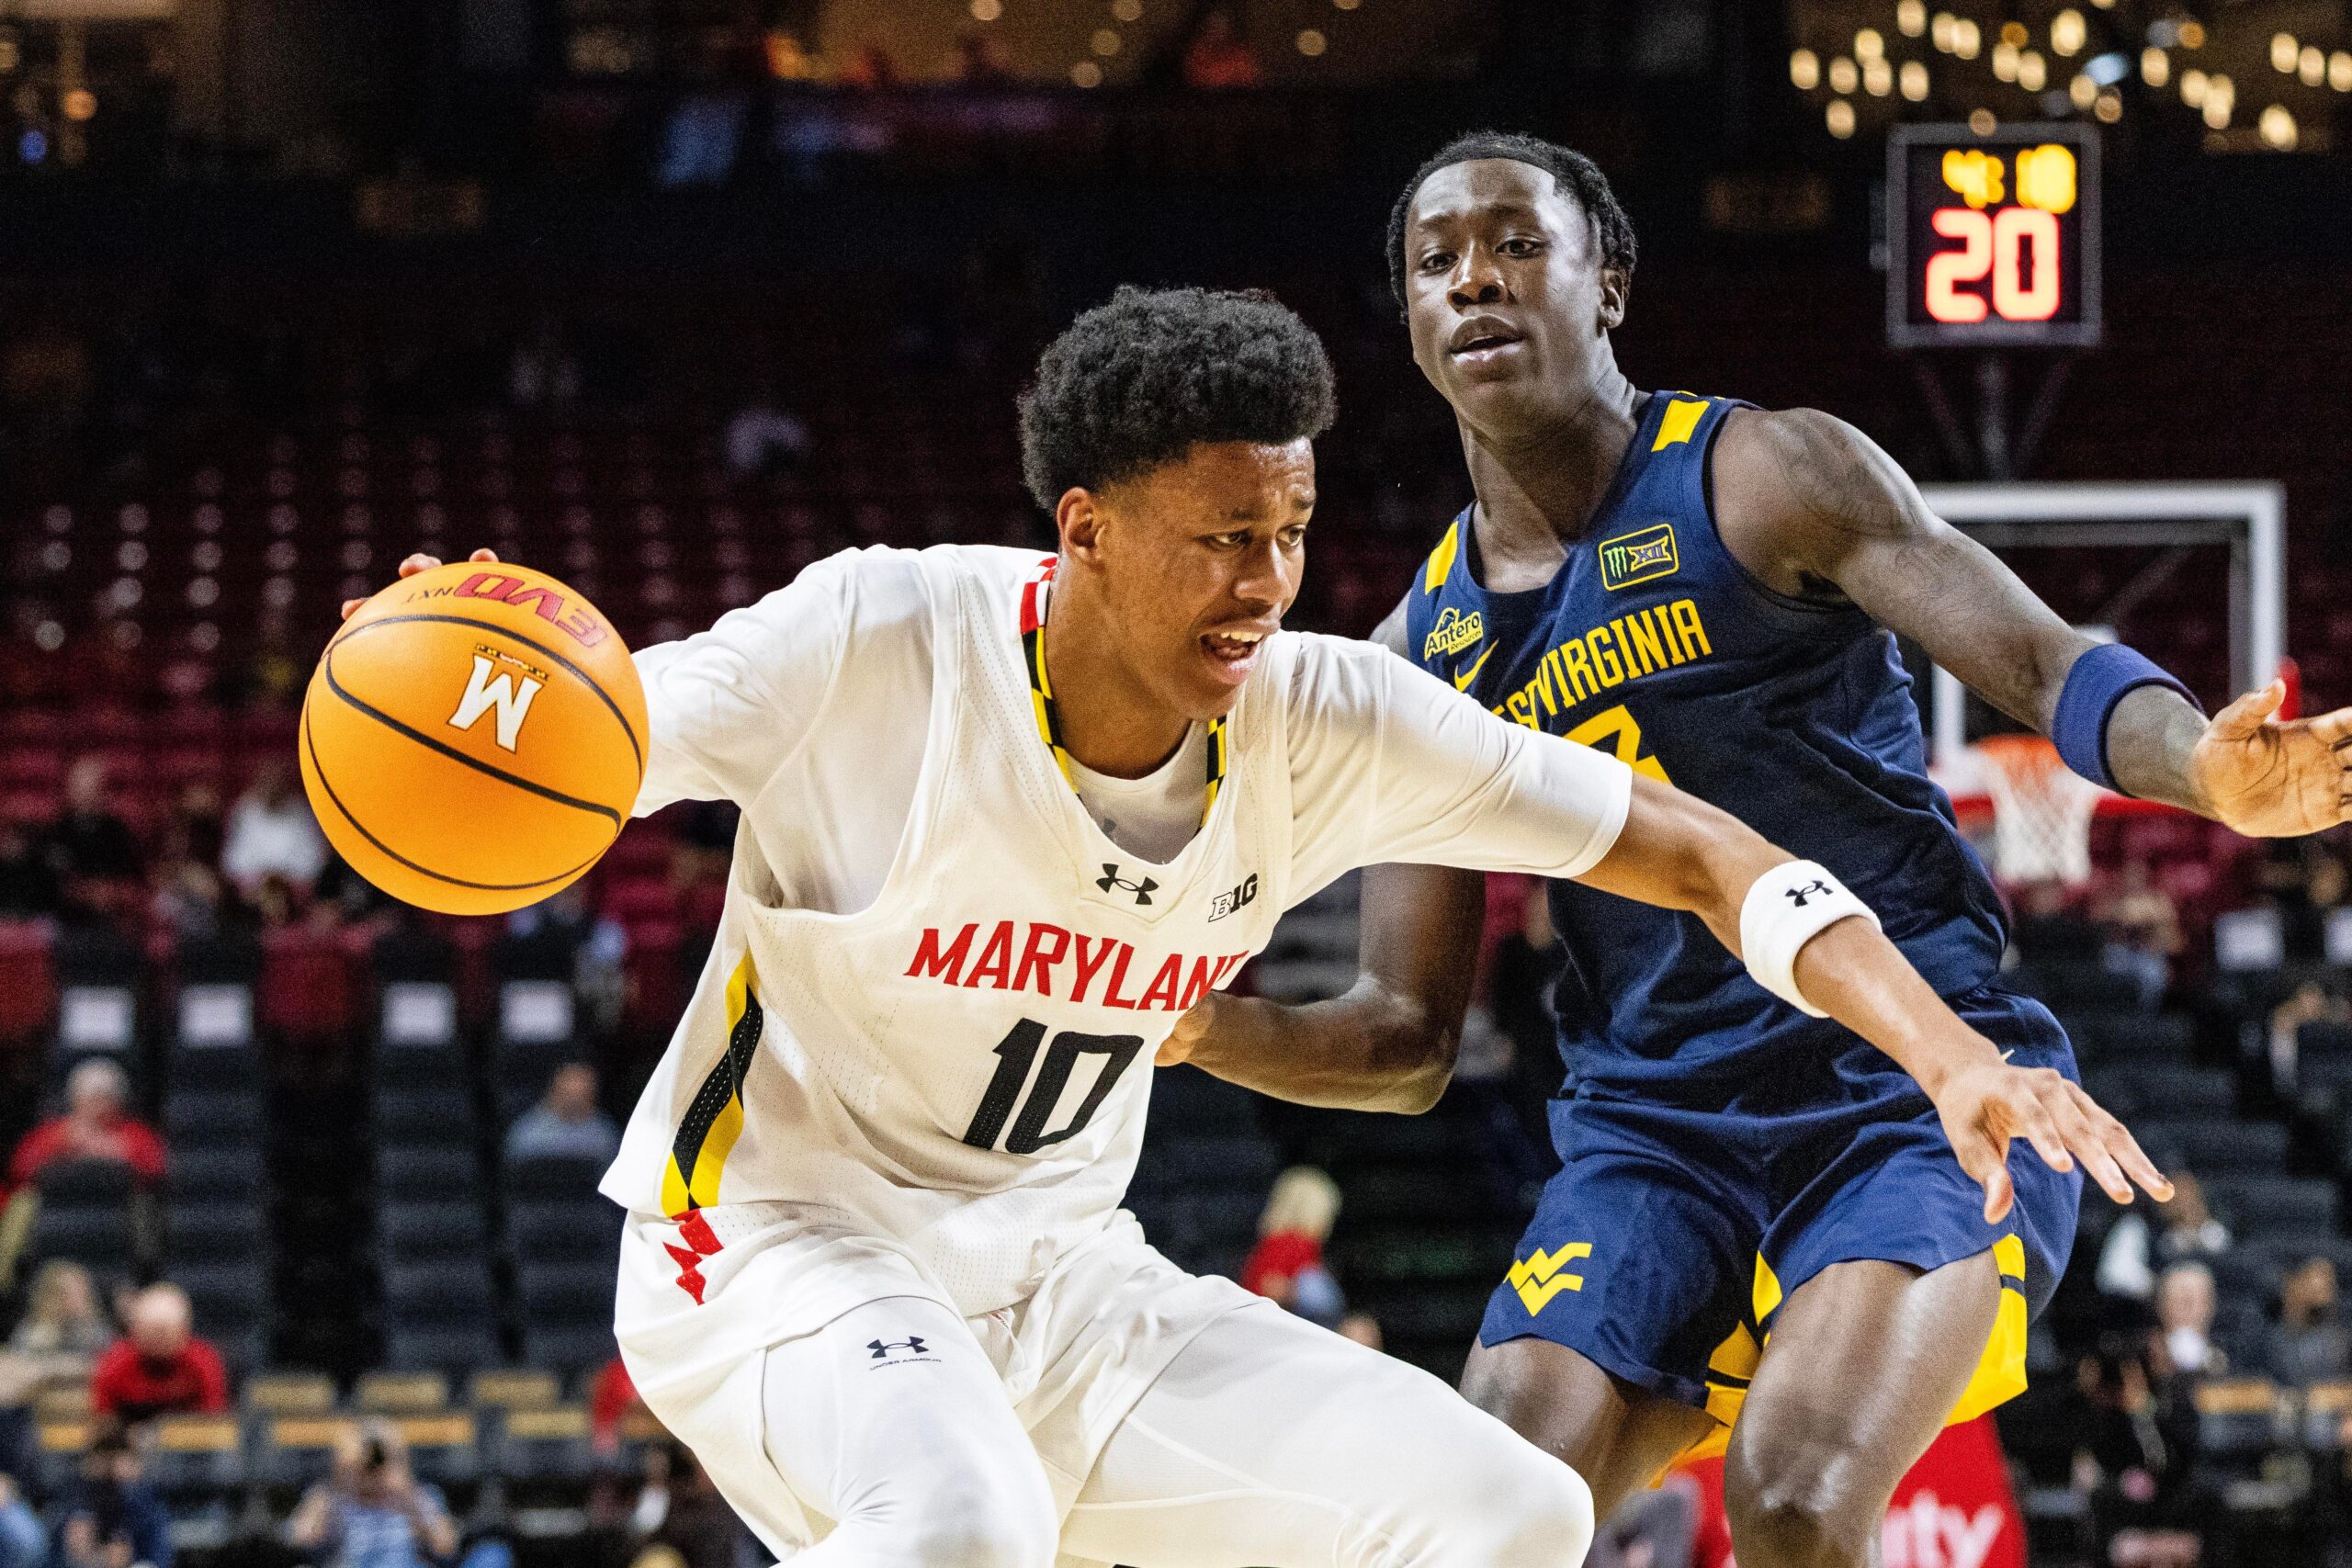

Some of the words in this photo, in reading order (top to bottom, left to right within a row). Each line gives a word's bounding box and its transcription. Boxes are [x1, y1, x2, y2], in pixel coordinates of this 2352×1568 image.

[1926, 206, 2062, 322] 20
[453, 571, 608, 649] EVO
[1426, 615, 1480, 655] Antero
[1536, 598, 1713, 716] VIRGINIA
[903, 920, 1250, 1011] MARYLAN
[962, 1016, 1145, 1155] 10
[869, 1359, 900, 1371] UNDER
